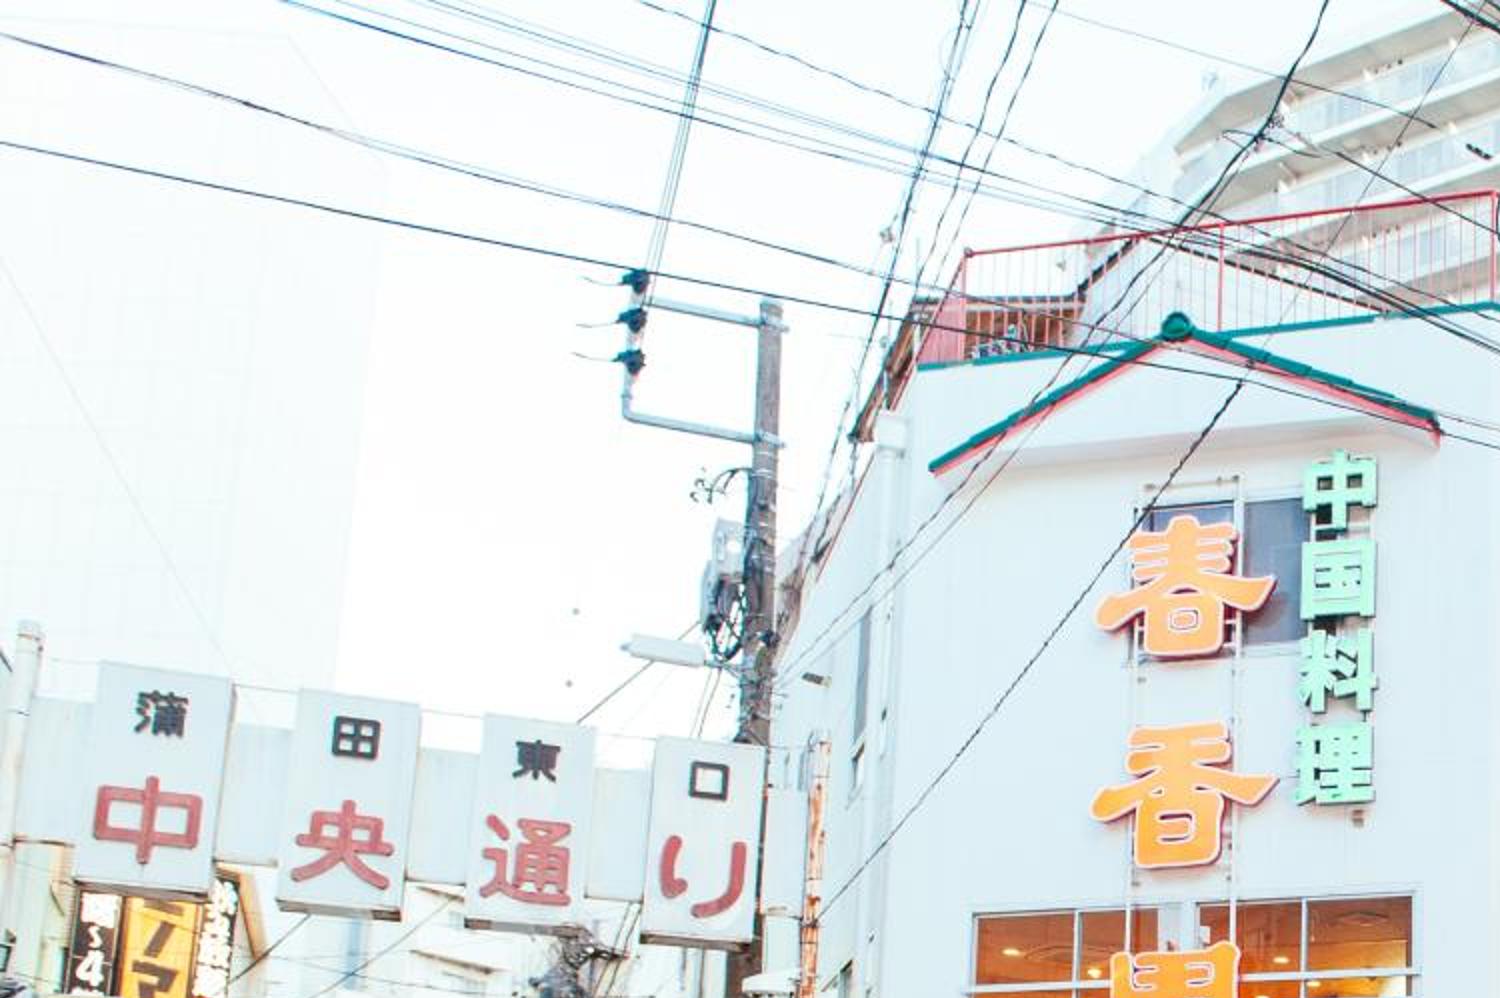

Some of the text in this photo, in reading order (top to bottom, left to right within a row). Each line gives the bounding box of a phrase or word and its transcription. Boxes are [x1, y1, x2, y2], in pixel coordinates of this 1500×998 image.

[1296, 450, 1379, 807] 中国料理
[134, 689, 731, 802] 蒲田東口
[92, 774, 748, 920] 中央通り
